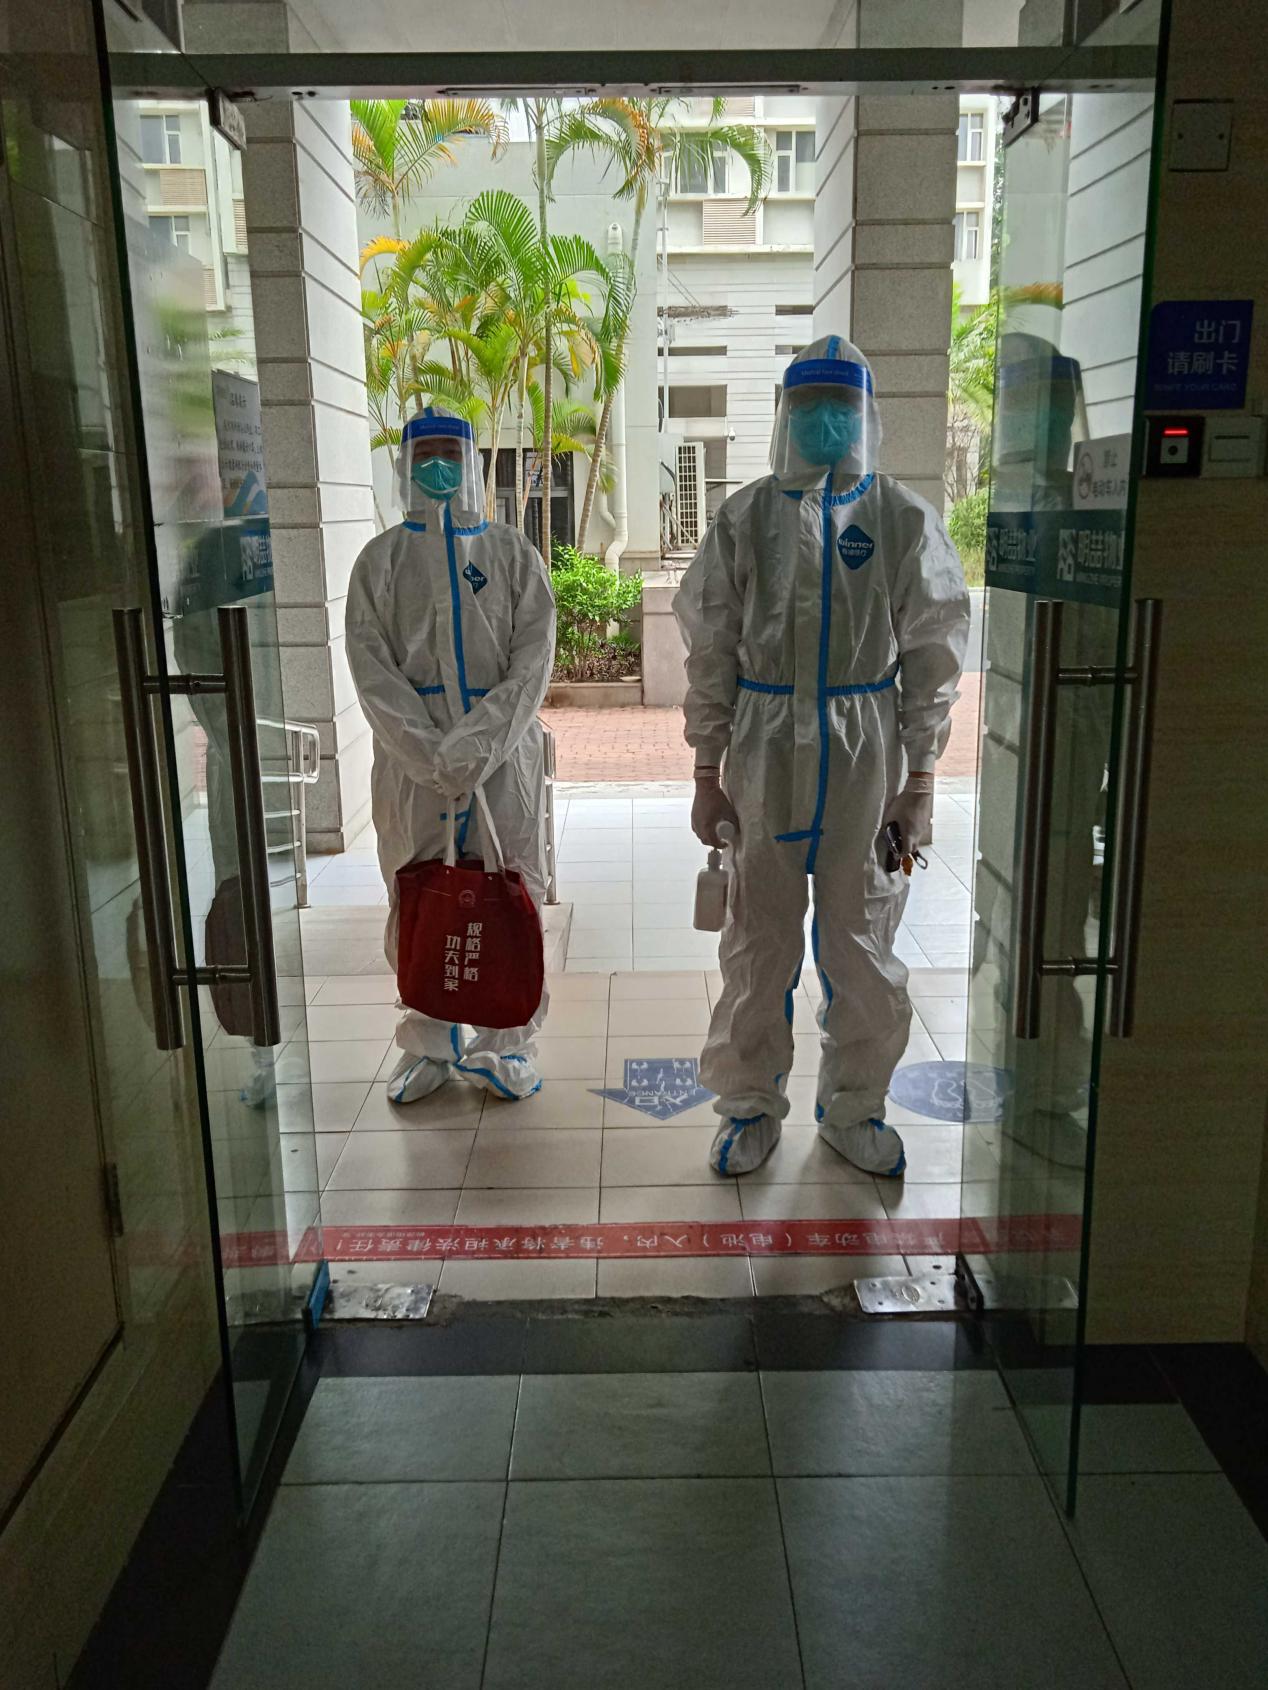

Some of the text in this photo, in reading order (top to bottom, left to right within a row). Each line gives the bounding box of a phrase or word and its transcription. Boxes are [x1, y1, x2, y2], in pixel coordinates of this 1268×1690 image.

[1194, 319, 1241, 344] 出门
[1167, 350, 1239, 376] 请刷卡
[443, 934, 461, 992] 功夫到家
[463, 922, 483, 982] 规格严格
[635, 1094, 688, 1106] 入口
